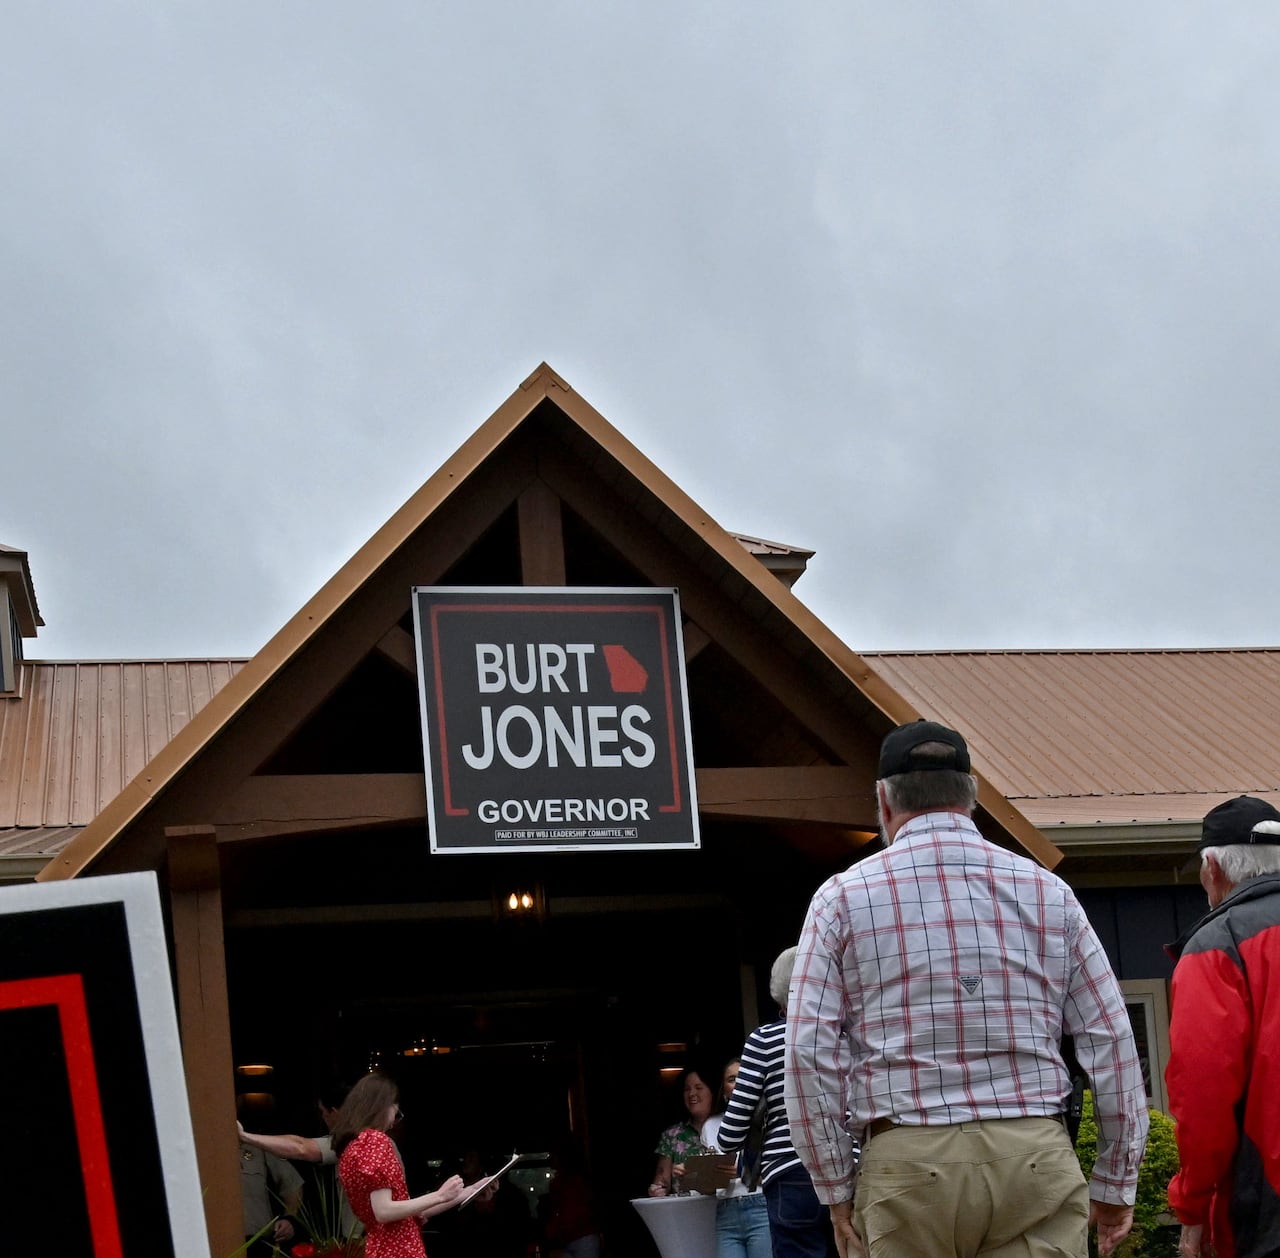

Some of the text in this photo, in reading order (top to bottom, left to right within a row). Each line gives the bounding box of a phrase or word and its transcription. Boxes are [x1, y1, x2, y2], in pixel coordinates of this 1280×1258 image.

[475, 643, 595, 694] BURT
[462, 704, 656, 770] JONES
[477, 798, 651, 824] GOVERNOR
[497, 831, 512, 839] PAID
[513, 831, 526, 839] FOR
[527, 831, 536, 839] BY
[549, 829, 587, 838] LEADERSHIP
